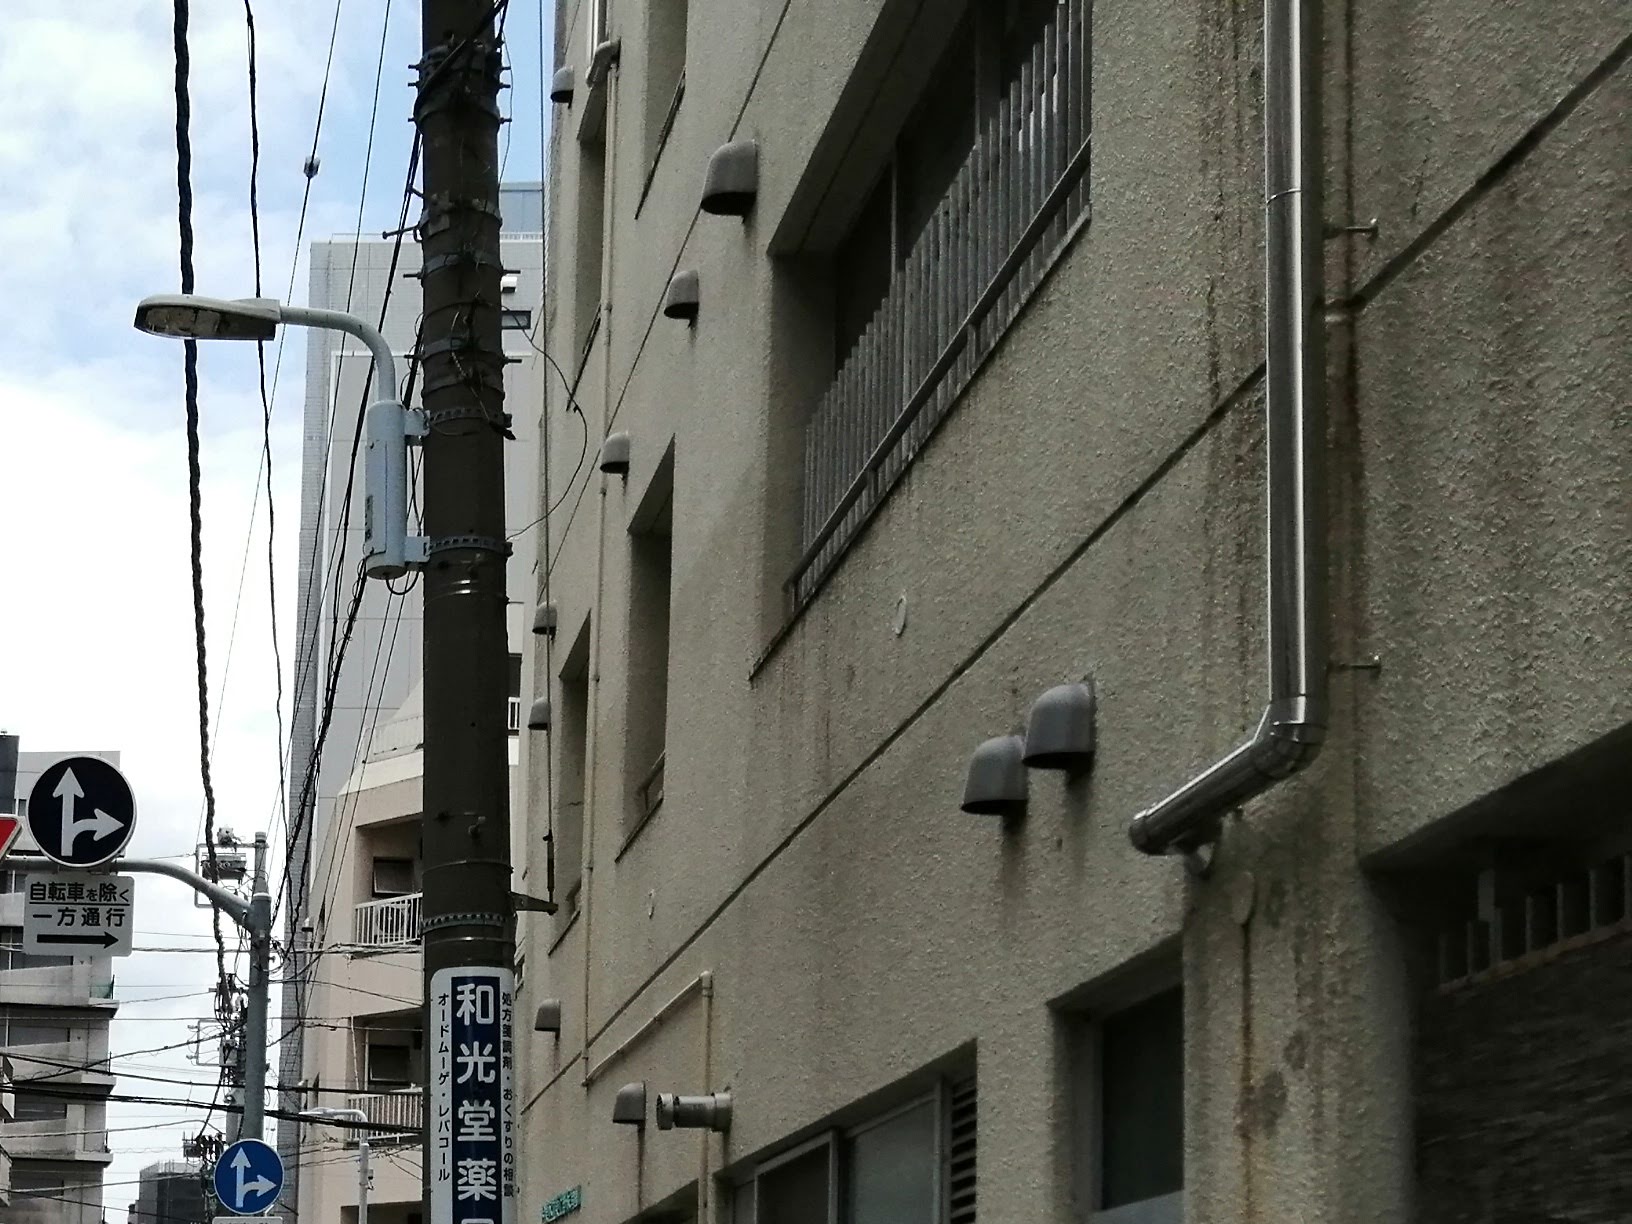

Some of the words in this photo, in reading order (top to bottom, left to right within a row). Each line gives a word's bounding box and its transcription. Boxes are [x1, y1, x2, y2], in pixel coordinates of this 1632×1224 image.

[30, 881, 129, 902] 自転車を除く
[32, 907, 126, 927] 一方通行
